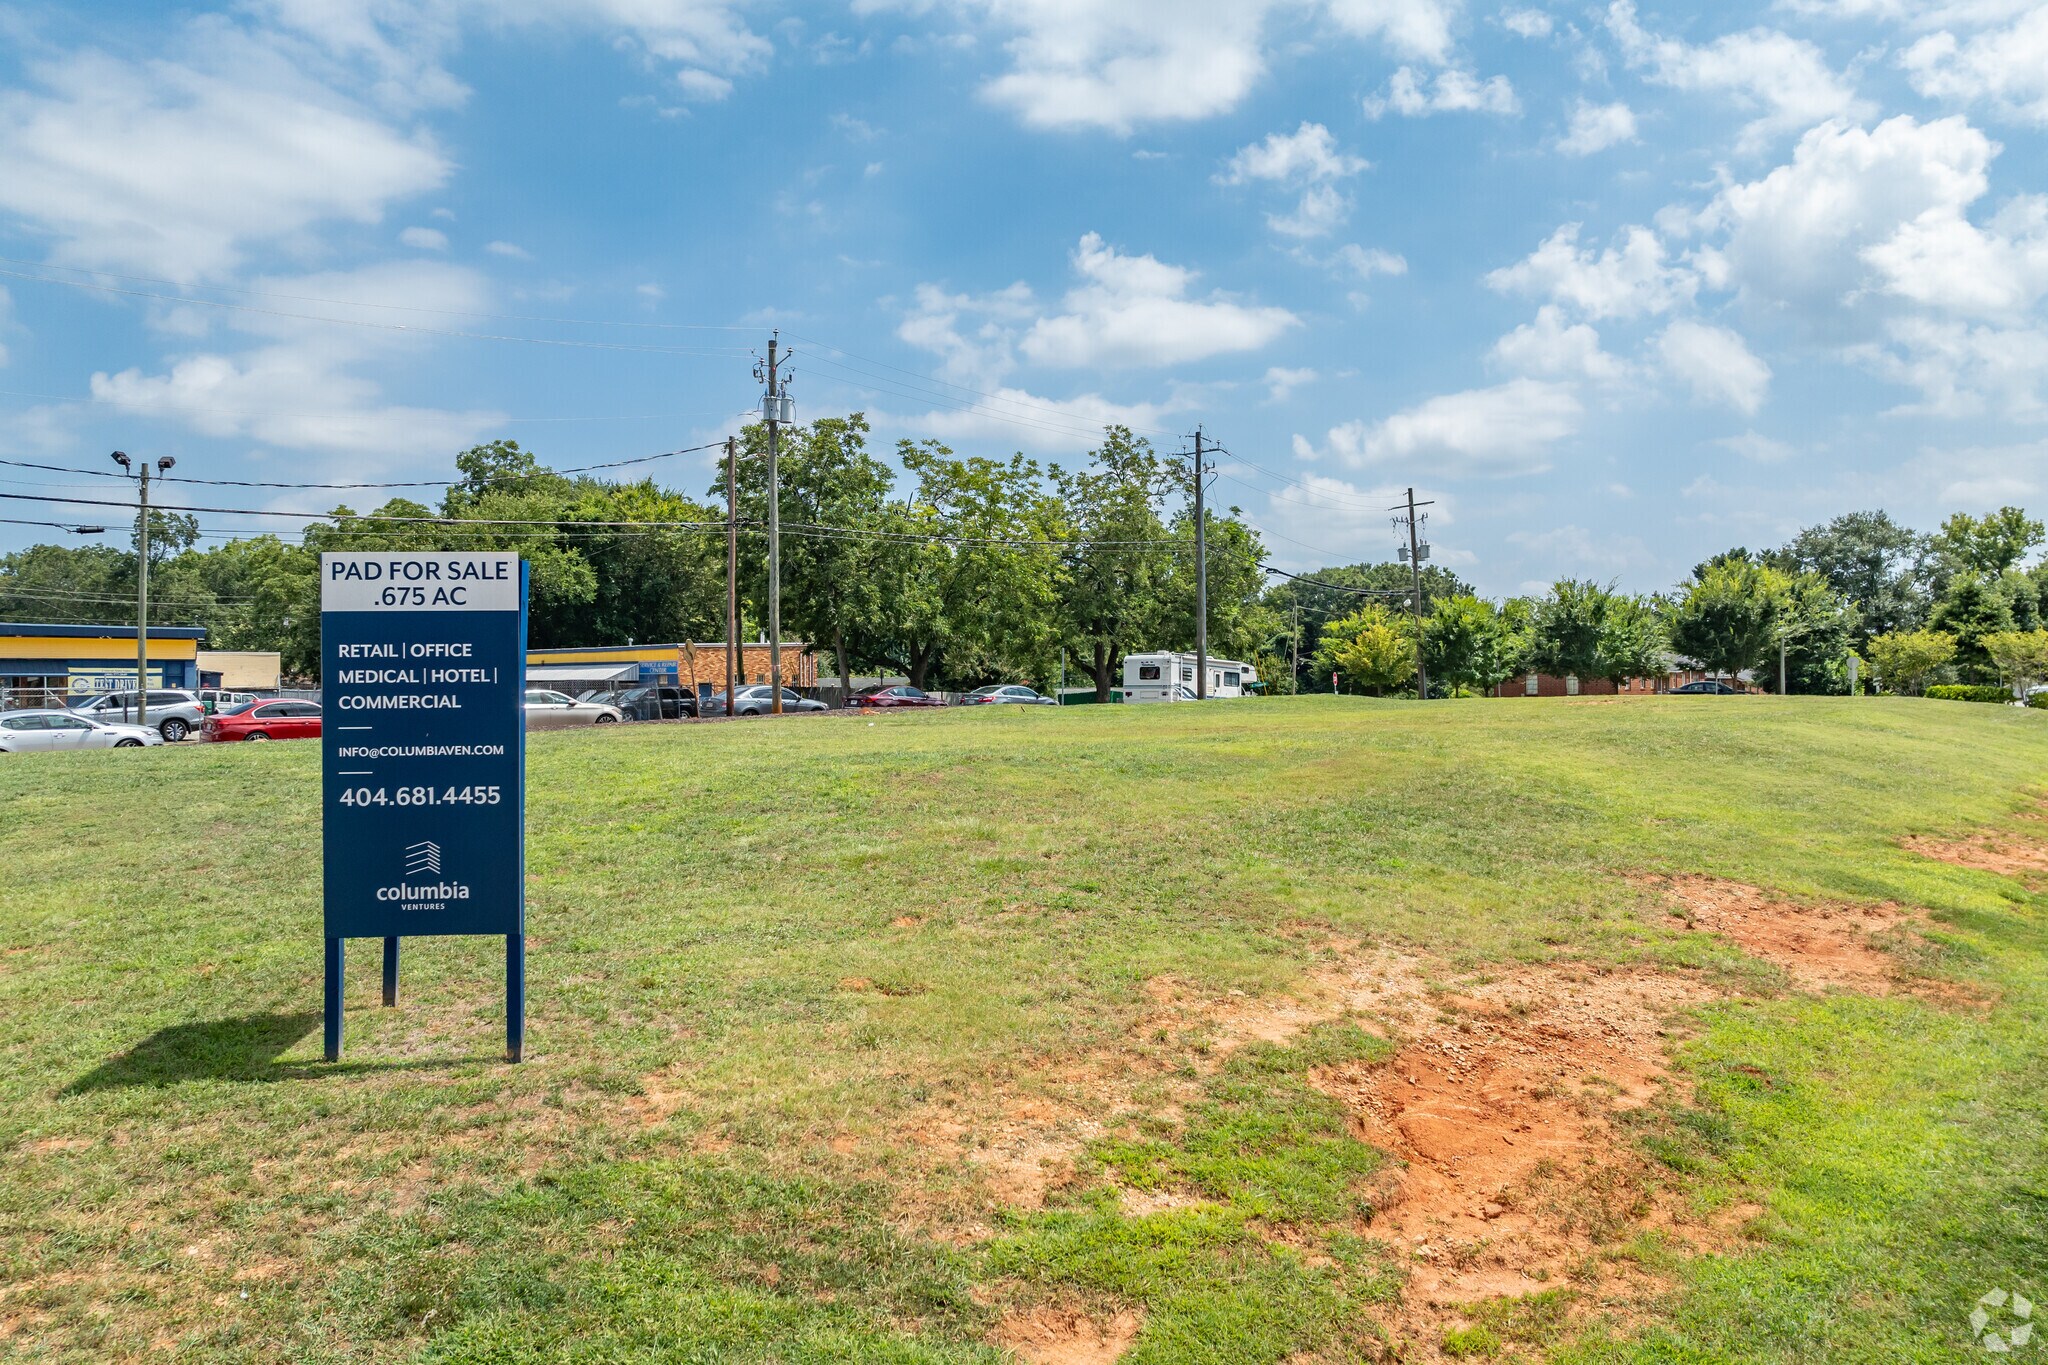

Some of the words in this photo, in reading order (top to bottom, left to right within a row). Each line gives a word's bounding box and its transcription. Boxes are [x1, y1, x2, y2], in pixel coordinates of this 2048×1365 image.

[331, 561, 382, 581] PAD
[389, 561, 441, 581] FOR
[447, 561, 509, 580] SALE
[374, 586, 425, 606] .675
[431, 586, 467, 606] AC
[338, 643, 399, 658] RETAIL
[410, 643, 472, 657] OFFICE
[338, 669, 420, 684] MEDICAL
[431, 668, 490, 683] HOTEL
[115, 679, 137, 690] DRIVE
[338, 695, 462, 710] COMMERCIAL
[338, 745, 504, 759] INFO@COLUMBIAVEN.COM
[339, 786, 501, 807] 404.681.4455
[376, 881, 470, 901] columbia
[401, 903, 446, 911] VENTURES
